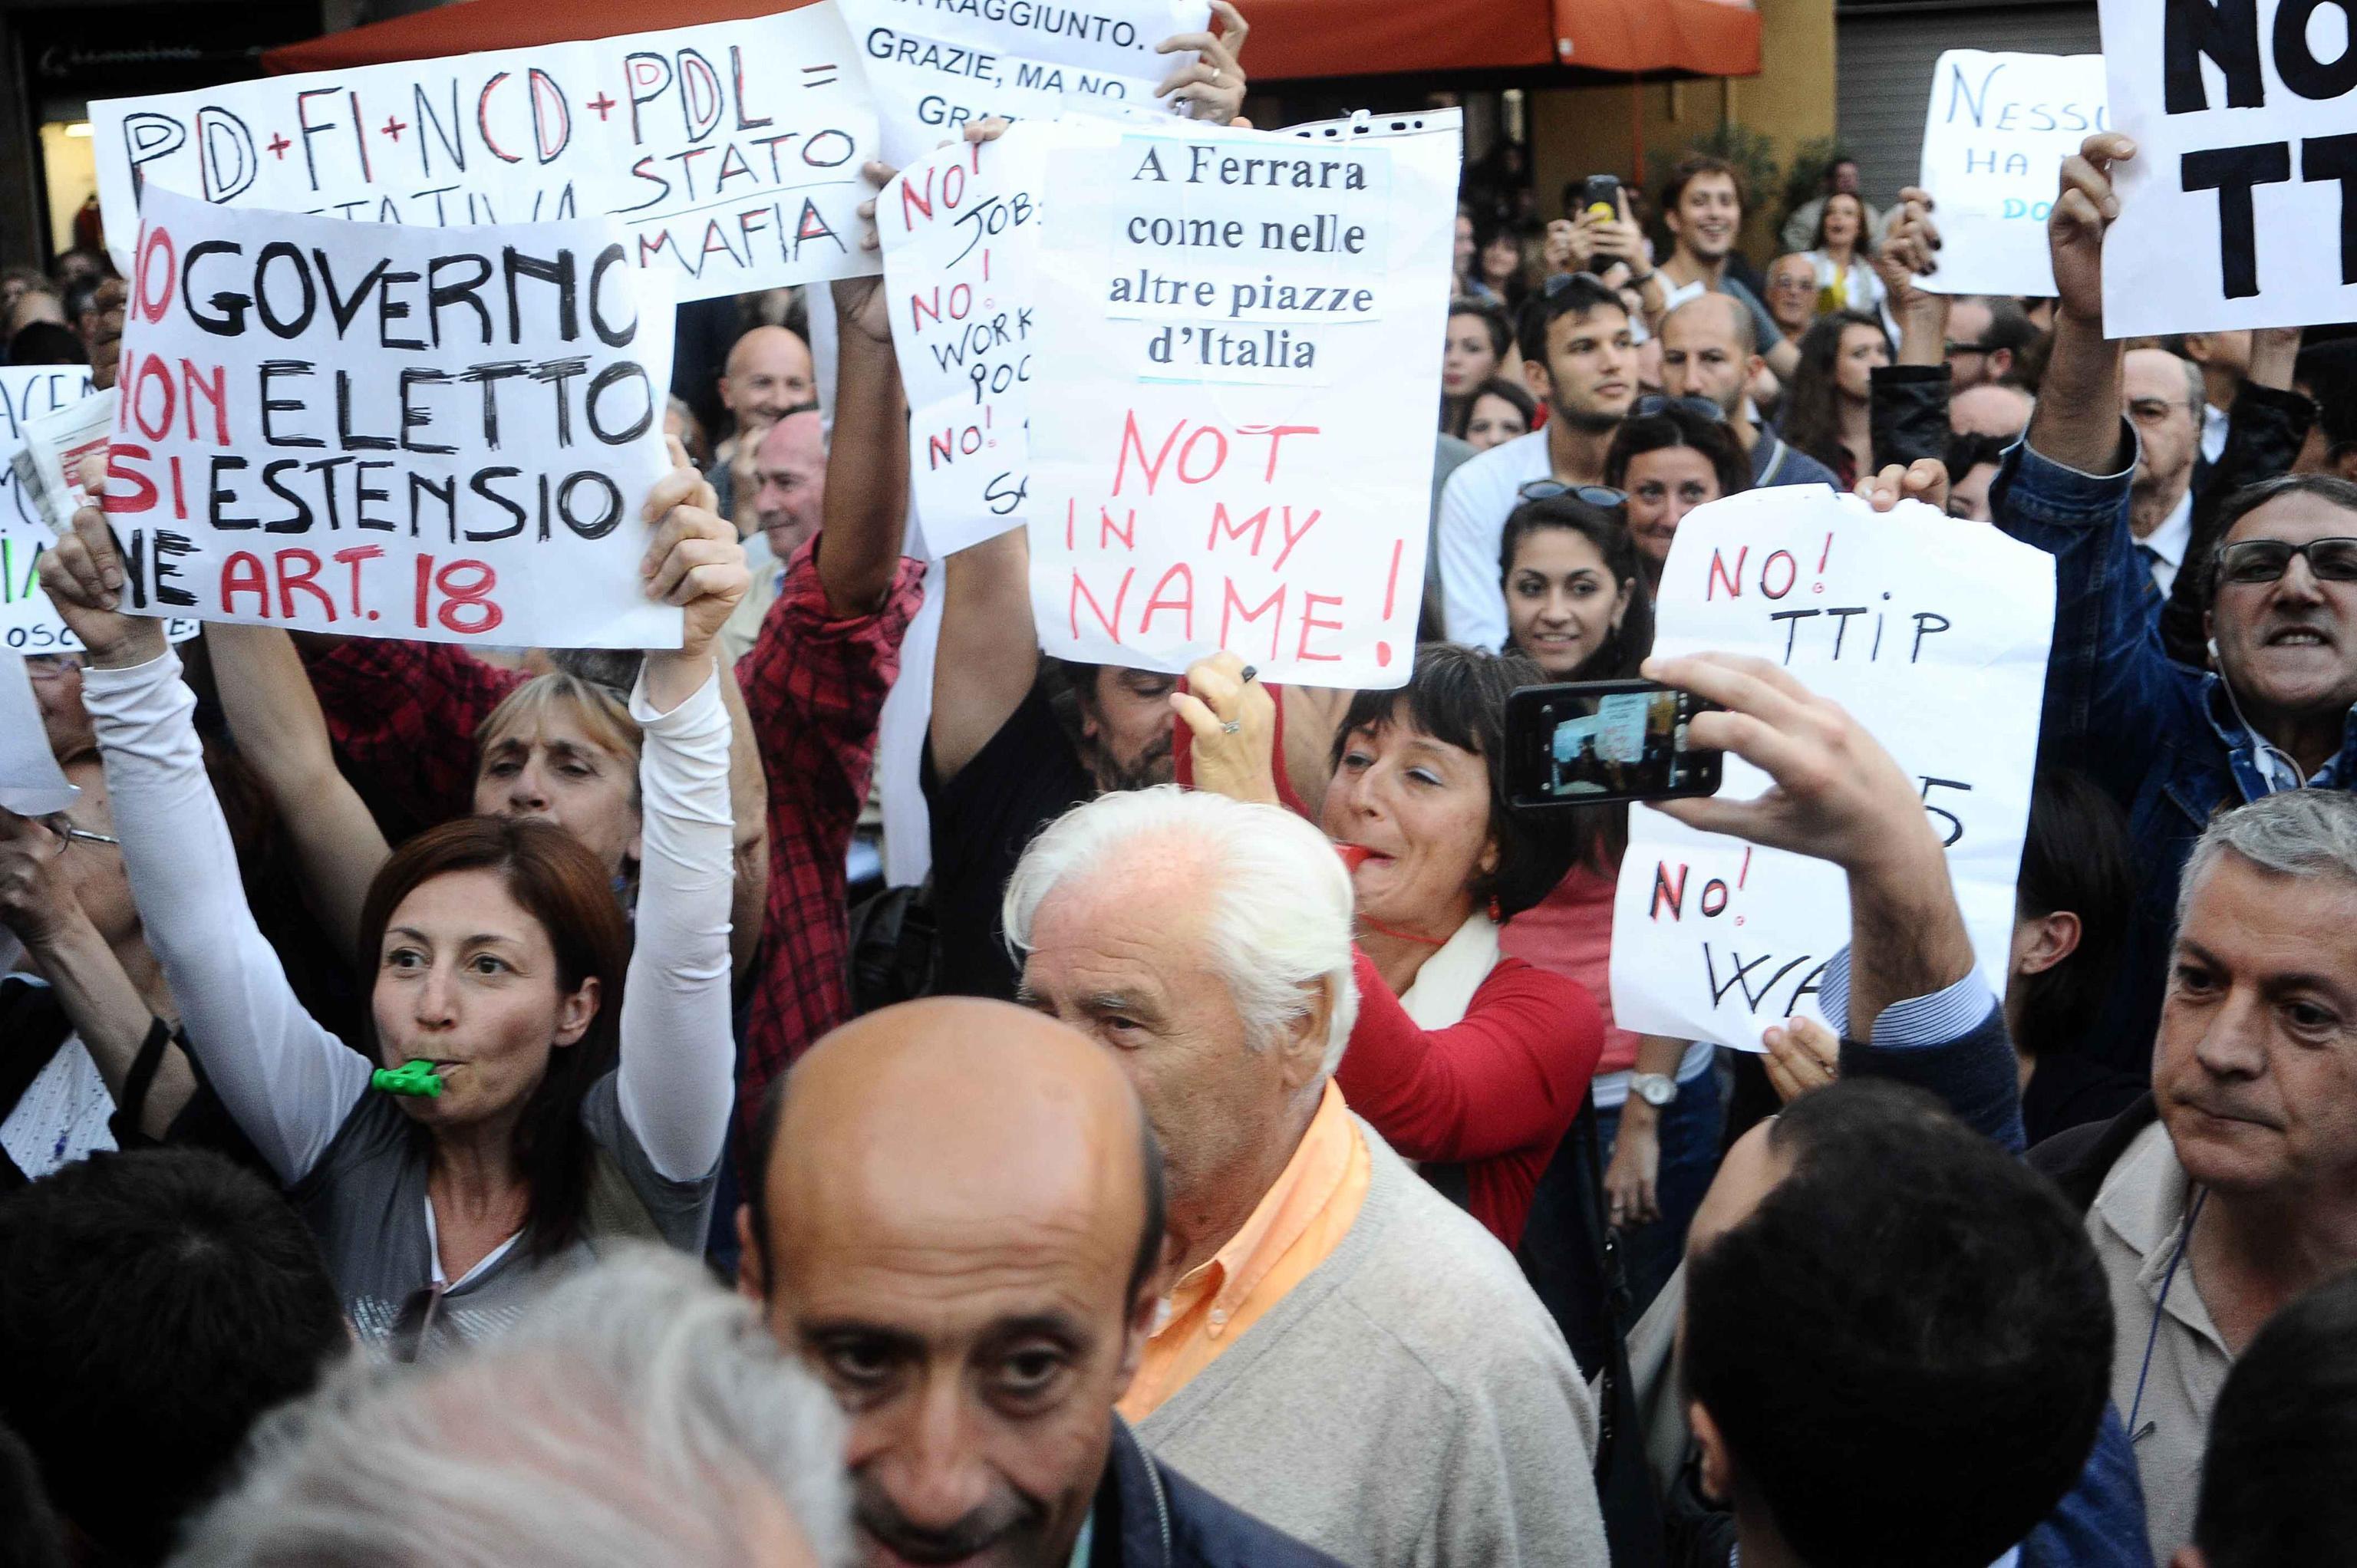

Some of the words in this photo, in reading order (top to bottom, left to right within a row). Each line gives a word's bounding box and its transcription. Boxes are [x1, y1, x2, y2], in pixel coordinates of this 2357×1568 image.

[866, 28, 1002, 88] GRAZIE,
[1017, 63, 1063, 94] MA
[605, 129, 855, 216] STATO
[1131, 146, 1170, 183] A
[1186, 146, 1367, 192] Ferrara
[1966, 148, 2027, 175] HA
[638, 196, 847, 280] MAFIA
[1128, 214, 1244, 252] come
[1260, 213, 1366, 255] nelle
[181, 239, 638, 350] GOVERNO
[910, 249, 995, 334] NO!
[1109, 268, 1215, 308] altre
[1228, 274, 1374, 318] piazze
[259, 354, 654, 455] ELETTO
[928, 405, 997, 471] NO!
[1113, 409, 1320, 496] NOT
[101, 443, 187, 520] SI
[209, 454, 625, 543] ESTENSIO
[1066, 497, 1135, 551] IN
[1207, 502, 1322, 572] MY
[1706, 532, 1834, 602] NO!
[221, 543, 381, 625] ART.
[414, 553, 504, 634] 18
